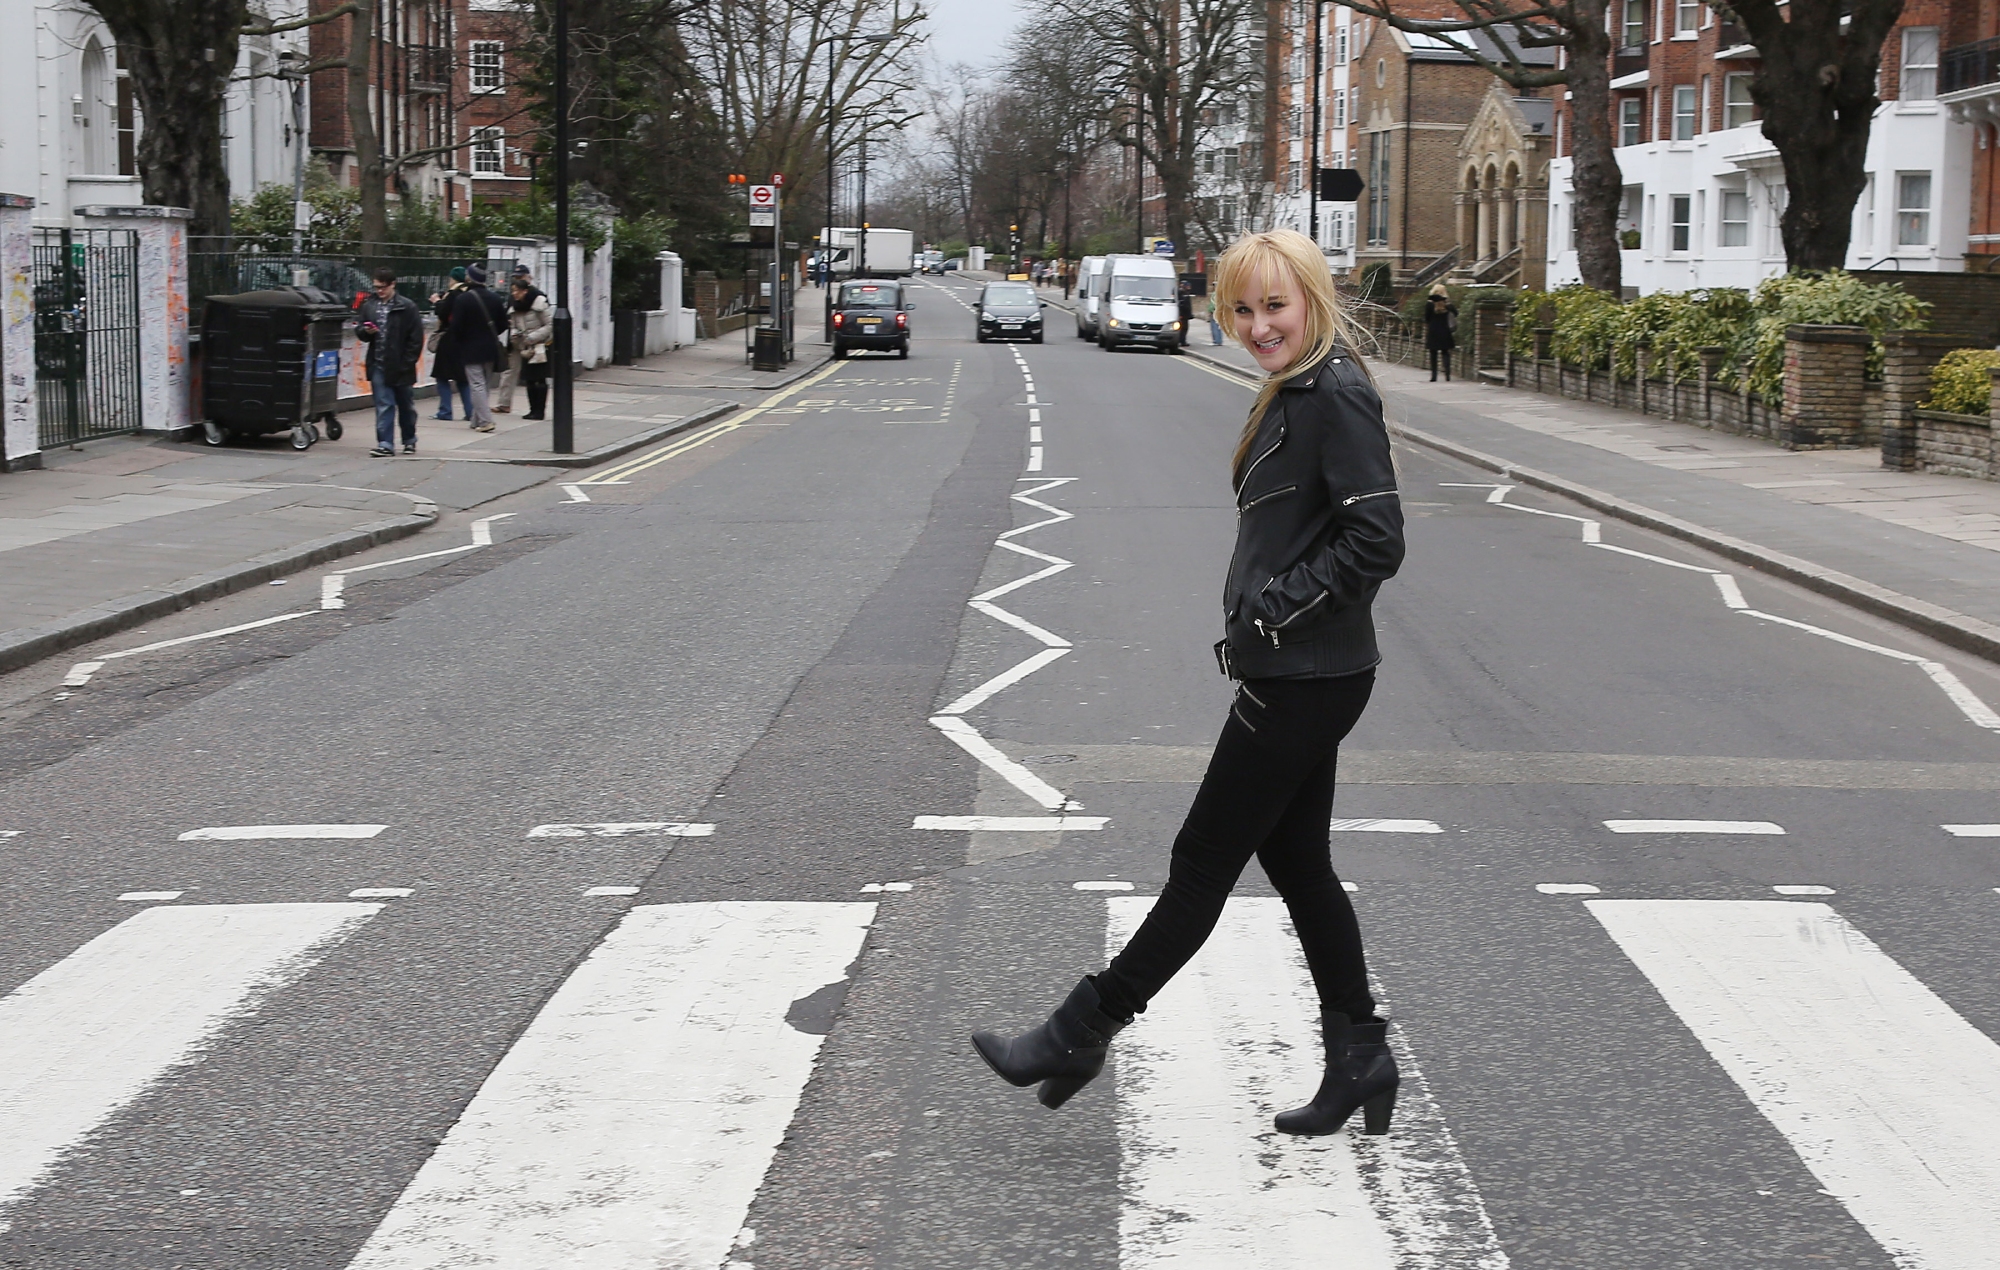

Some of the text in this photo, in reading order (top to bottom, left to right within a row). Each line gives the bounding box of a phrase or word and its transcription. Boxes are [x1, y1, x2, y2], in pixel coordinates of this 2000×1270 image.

[773, 174, 783, 184] R
[796, 398, 918, 407] BUS
[765, 405, 935, 414] STOP
